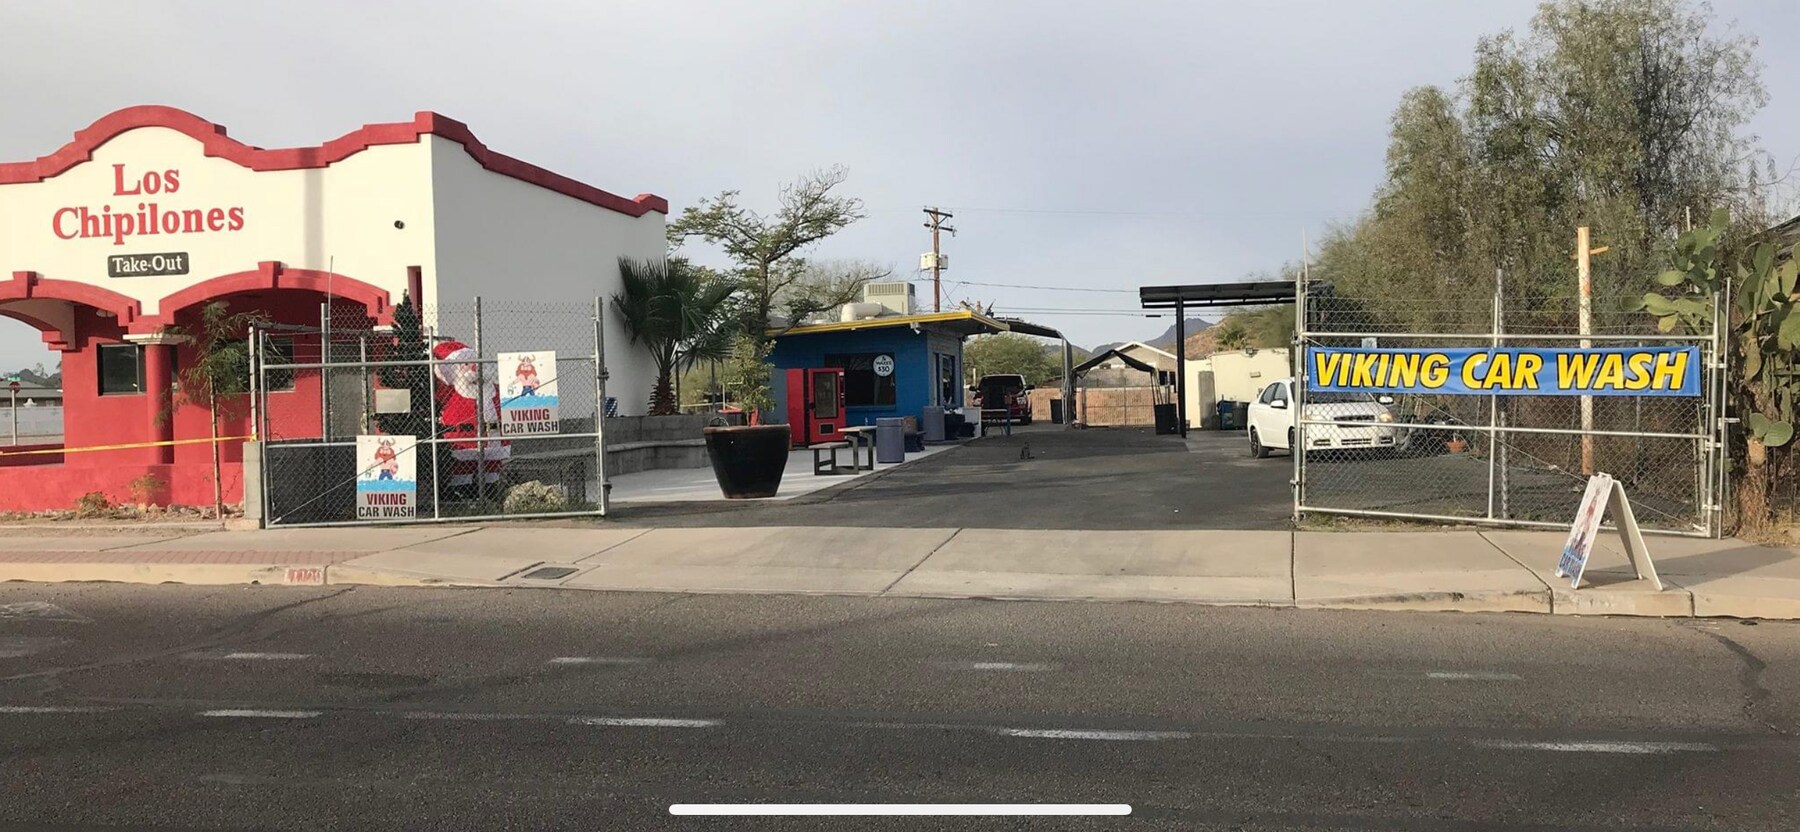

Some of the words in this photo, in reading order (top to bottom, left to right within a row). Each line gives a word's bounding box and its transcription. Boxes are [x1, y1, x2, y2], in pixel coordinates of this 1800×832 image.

[112, 163, 180, 196] Los
[52, 202, 245, 246] Chipilones
[111, 255, 184, 273] Take-Out
[1314, 352, 1450, 390] VIKING
[1460, 352, 1544, 390] CAR
[1556, 351, 1689, 391] WASH
[510, 408, 550, 422] VIKING
[503, 423, 524, 434] CAR
[527, 421, 558, 433] WASH
[366, 493, 407, 506] VIKING
[358, 506, 380, 518] CAR
[383, 506, 415, 518] WASH
